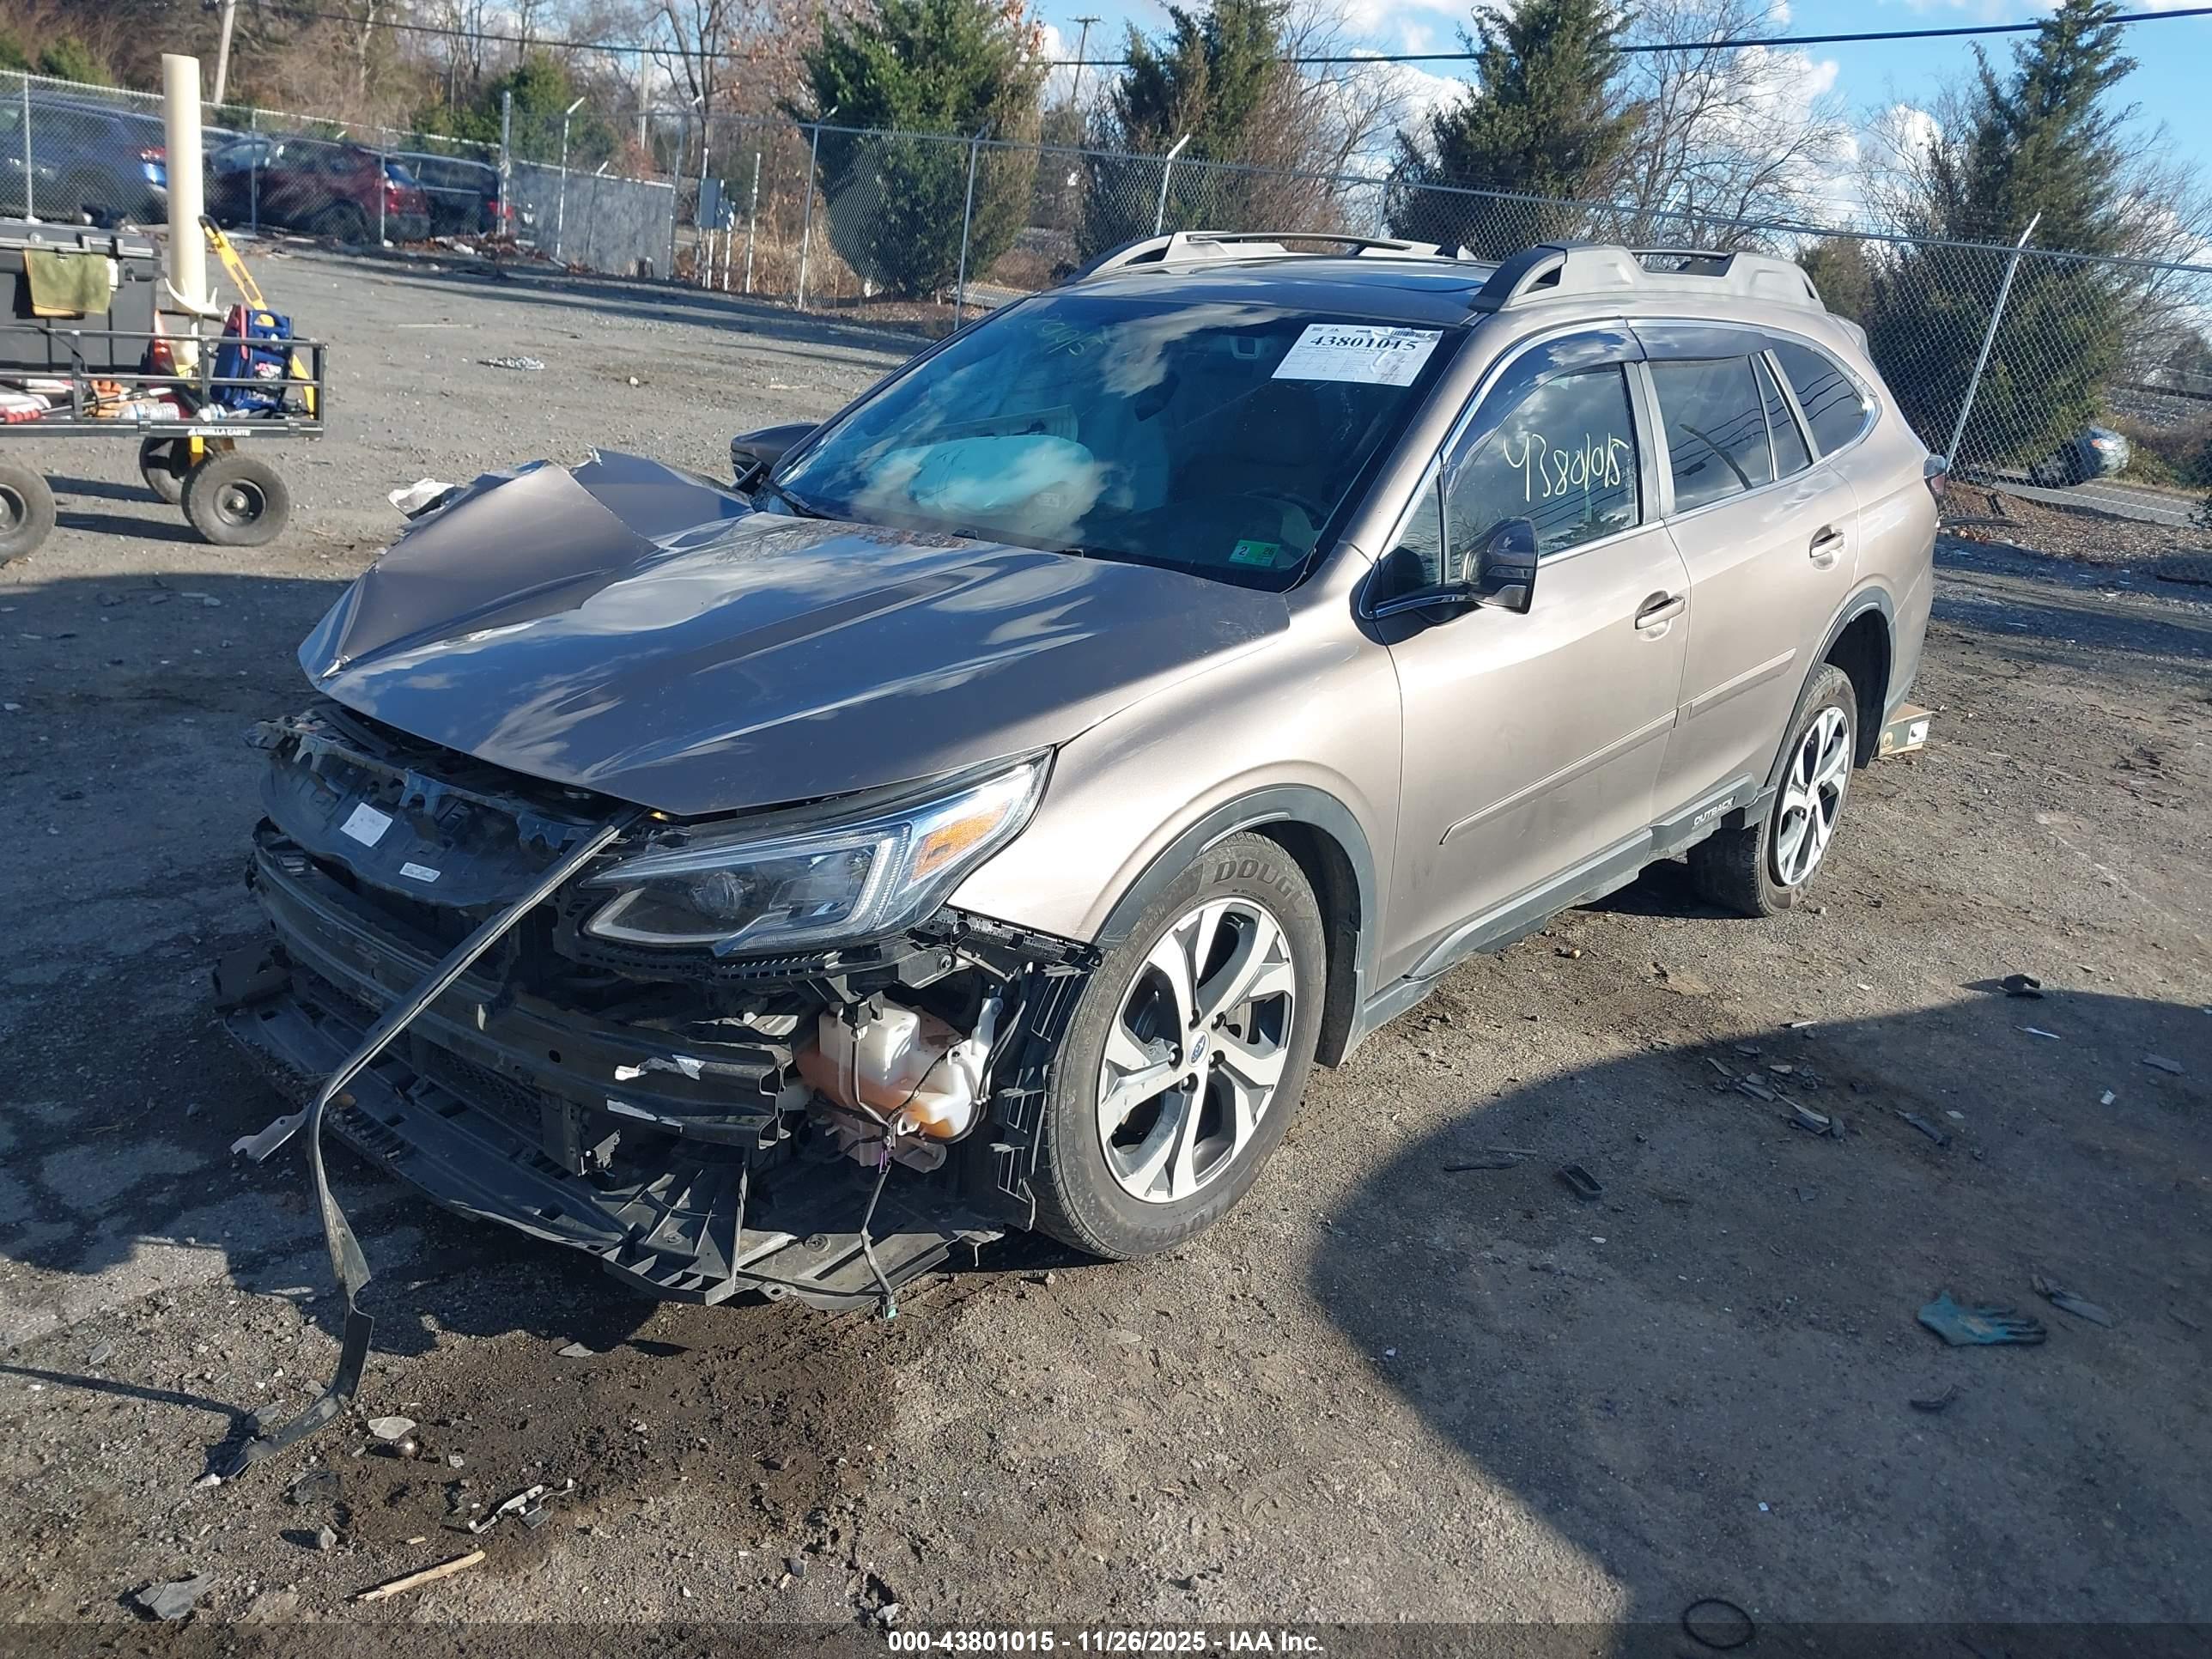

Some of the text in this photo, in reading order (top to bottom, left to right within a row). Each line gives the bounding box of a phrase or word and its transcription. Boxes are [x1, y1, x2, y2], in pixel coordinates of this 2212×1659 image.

[1310, 334, 1420, 352] 43801015
[1503, 432, 1630, 502] 43801015
[1693, 796, 1735, 826] OUTBACK
